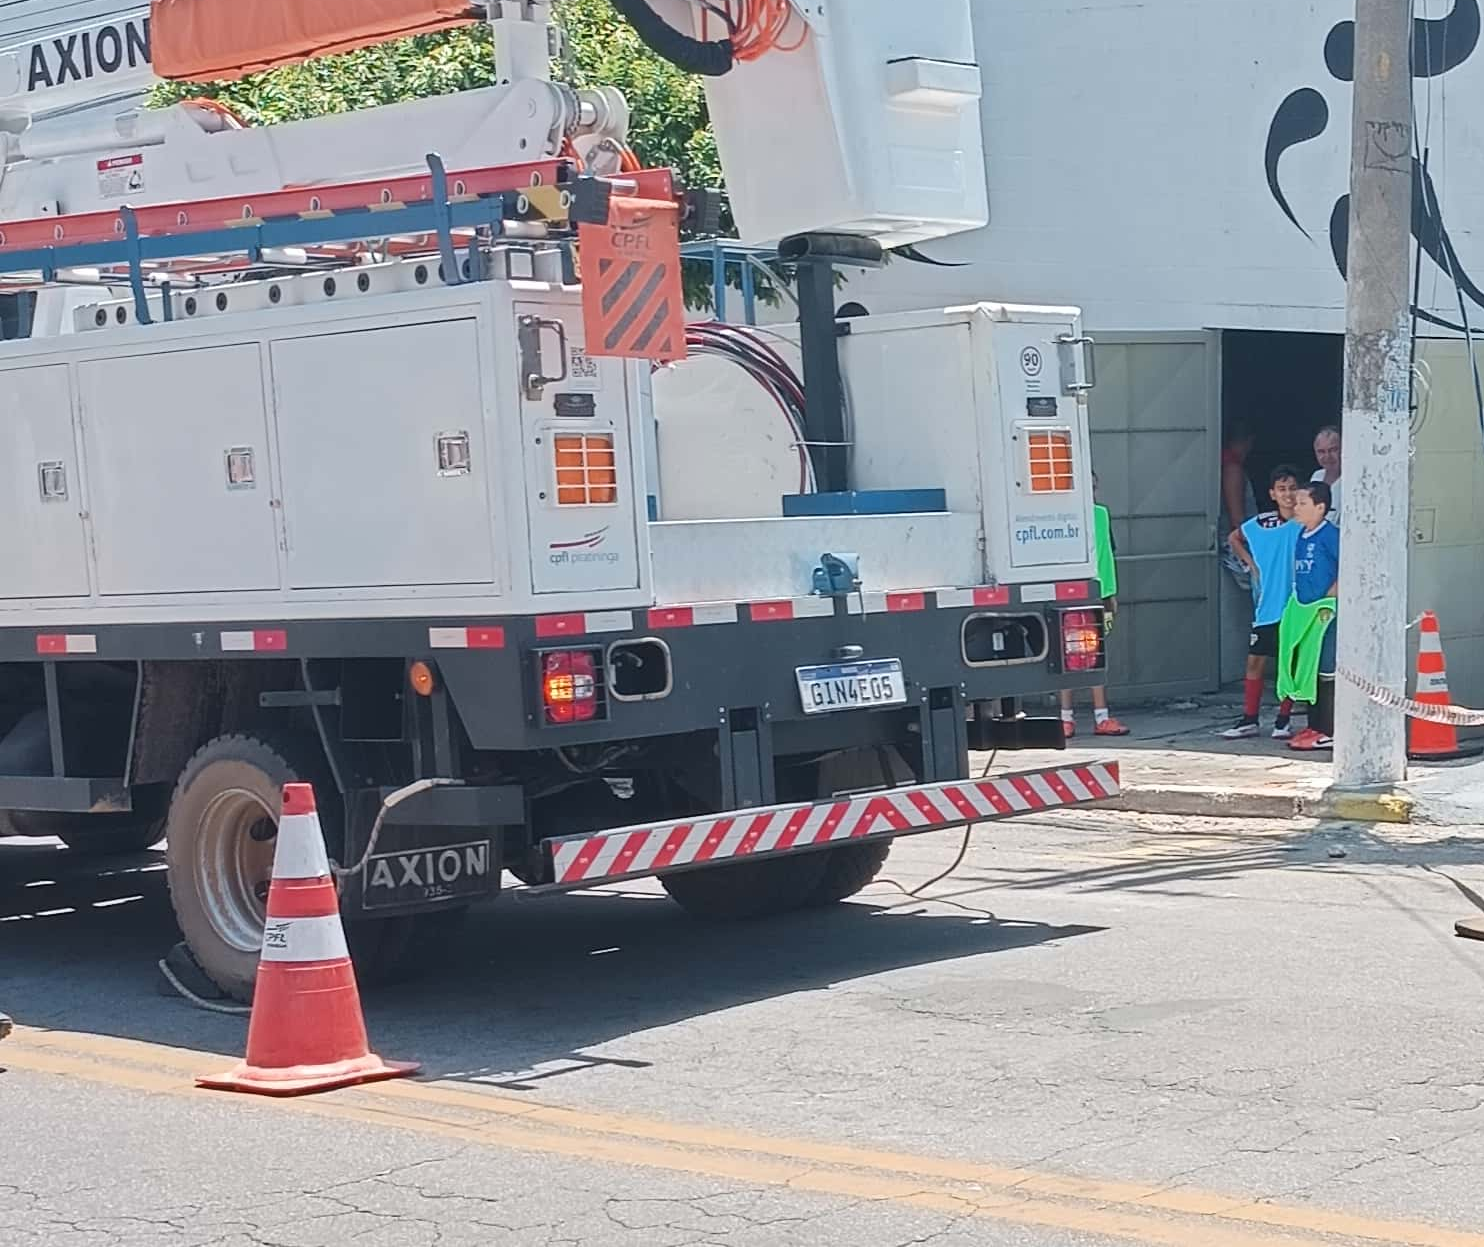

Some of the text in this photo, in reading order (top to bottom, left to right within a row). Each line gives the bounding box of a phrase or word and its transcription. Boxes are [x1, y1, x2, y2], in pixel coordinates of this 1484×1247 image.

[27, 18, 153, 92] AXION
[1015, 523, 1079, 545] cpfl.com.br
[810, 675, 894, 706] GIN4E05
[371, 845, 487, 889] AXION
